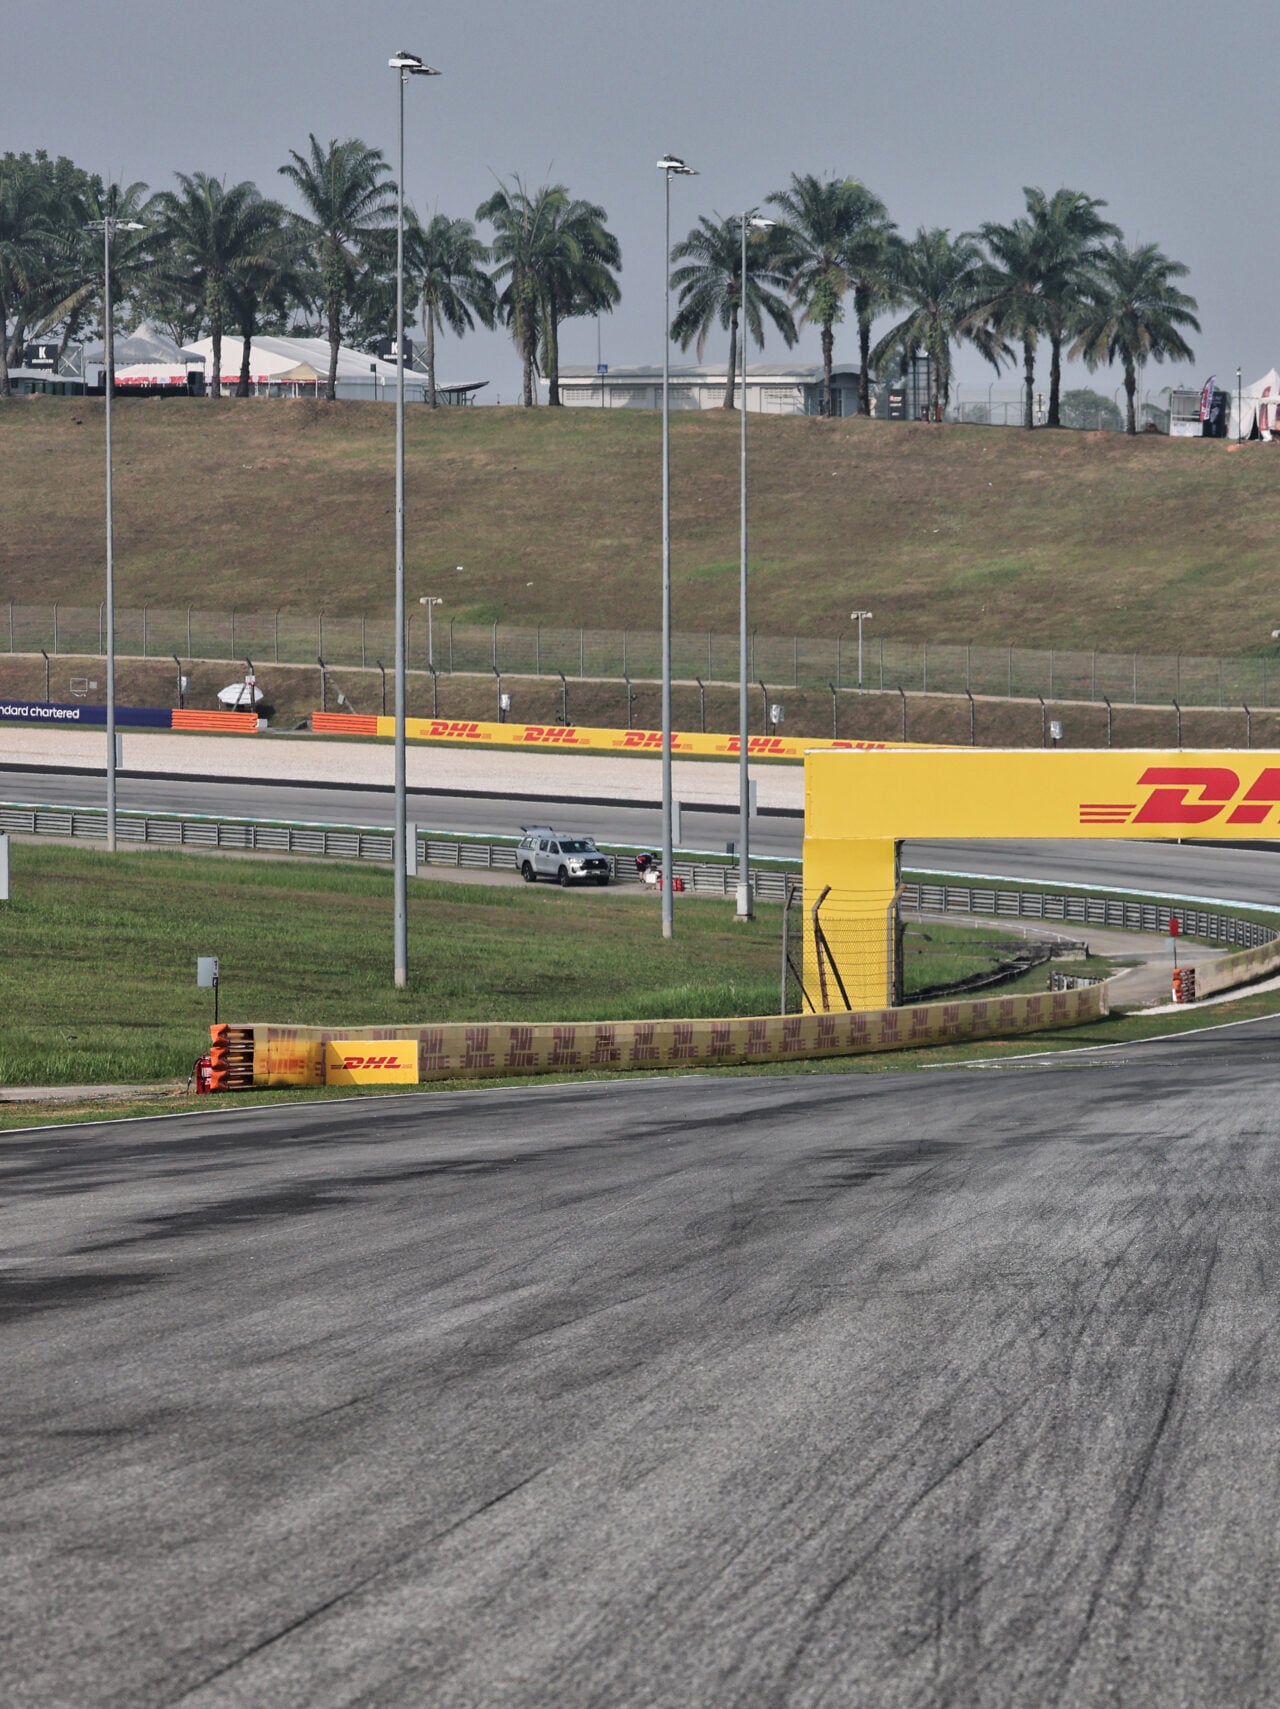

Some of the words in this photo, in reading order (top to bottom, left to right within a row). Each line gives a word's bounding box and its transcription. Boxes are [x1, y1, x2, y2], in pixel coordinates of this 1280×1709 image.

[38, 346, 47, 359] K
[30, 706, 80, 719] chartered
[430, 721, 482, 739] DHL
[523, 727, 580, 744] DHL
[342, 1056, 402, 1069] DHL
